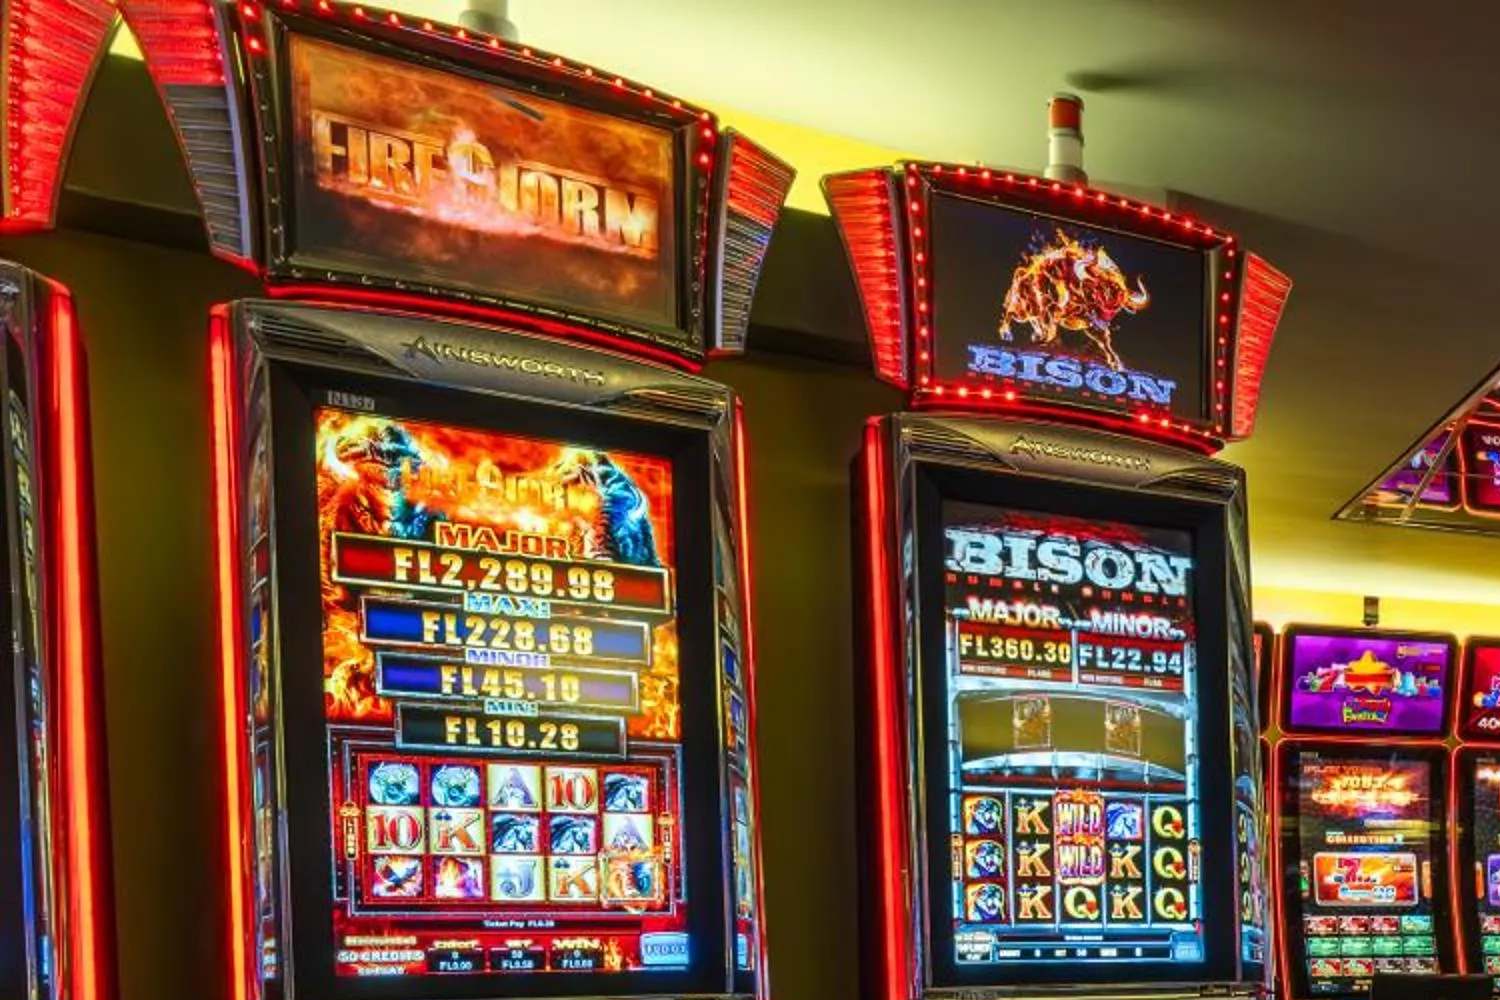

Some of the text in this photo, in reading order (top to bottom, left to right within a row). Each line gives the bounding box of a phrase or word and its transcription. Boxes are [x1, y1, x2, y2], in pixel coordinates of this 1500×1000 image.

[413, 335, 606, 386] AINSWORTH
[967, 344, 1177, 405] BISON
[436, 521, 572, 559] MAJOR
[393, 547, 615, 601] FL2,289.98
[944, 526, 1195, 597] BISON
[464, 591, 551, 619] MAXI
[967, 596, 1062, 630] MAJOR
[421, 612, 593, 655] FL228.68
[1089, 608, 1172, 640] MINOR
[466, 649, 550, 667] MINOR
[959, 632, 1071, 664] FL360.30
[1078, 643, 1182, 674] FL22.94
[440, 665, 580, 701] FL45.10
[445, 716, 579, 751] FL10.28
[550, 773, 595, 808] 10
[371, 813, 423, 851] 10
[435, 813, 482, 853] K
[1015, 799, 1050, 834] K
[1056, 801, 1102, 837] WILD
[558, 858, 595, 898] K
[1016, 842, 1051, 878] K
[1057, 843, 1104, 879] WILD
[1109, 844, 1143, 879] K
[1019, 884, 1053, 919] K
[1110, 884, 1143, 919] K
